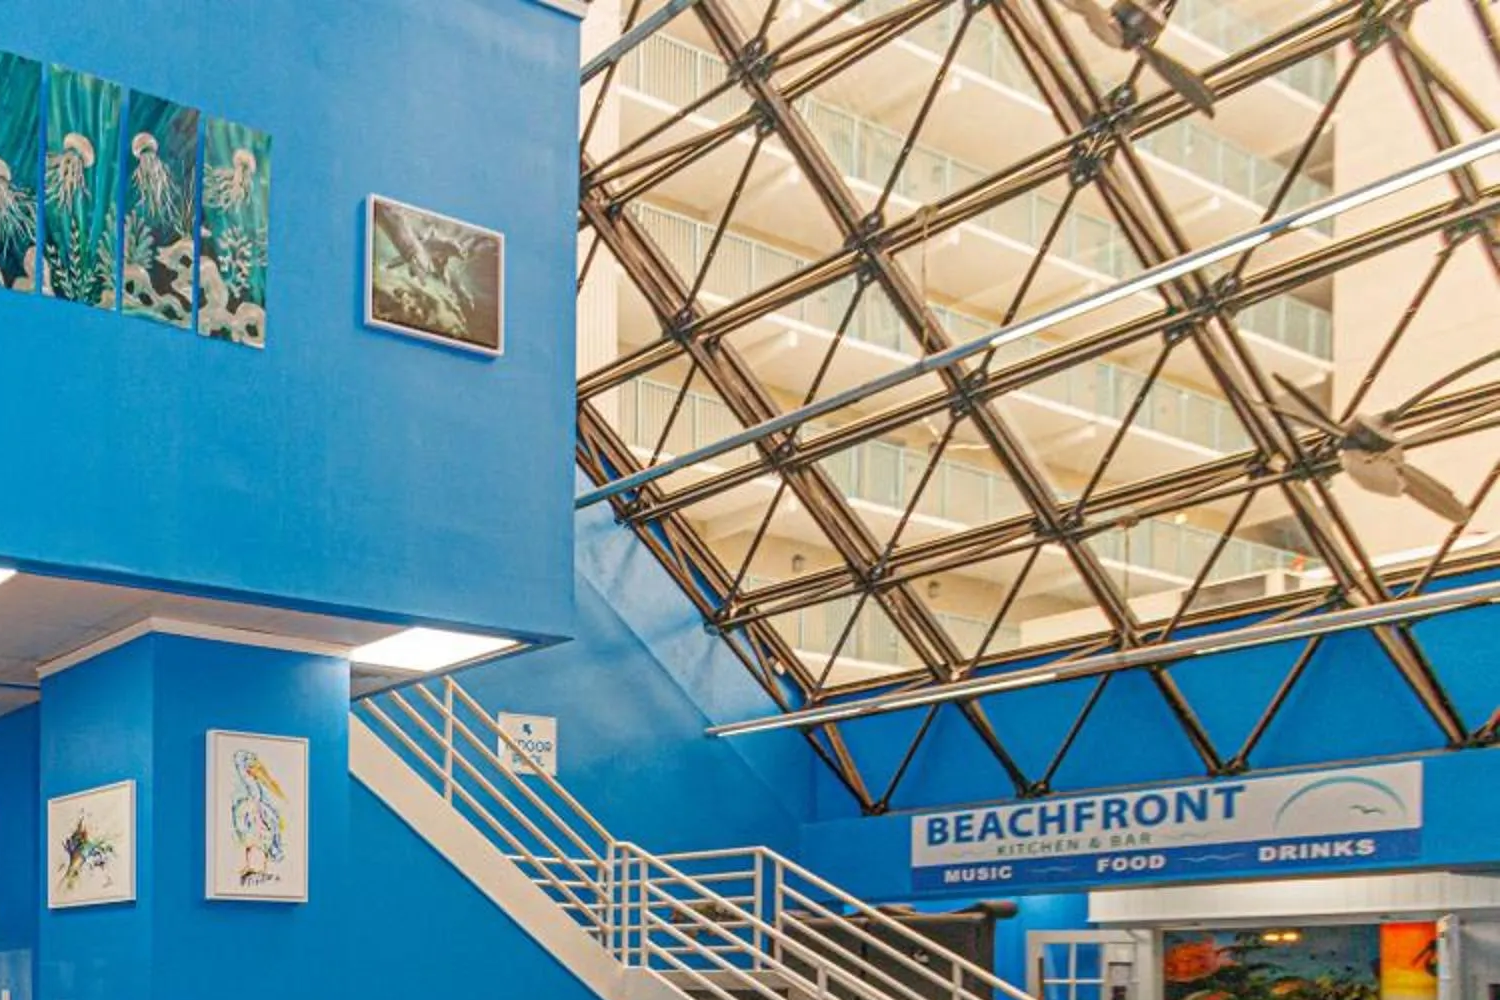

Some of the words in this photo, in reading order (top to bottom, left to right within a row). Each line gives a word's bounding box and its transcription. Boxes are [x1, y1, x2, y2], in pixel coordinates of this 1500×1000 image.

[927, 785, 1247, 847] BEACHFRONT
[944, 865, 1013, 884] MUSIC
[1096, 854, 1167, 873] FOOD
[1258, 839, 1377, 862] DRINKS
[997, 839, 1079, 856] KITCHEN
[1089, 837, 1101, 849] &
[1110, 832, 1152, 848] BAR
